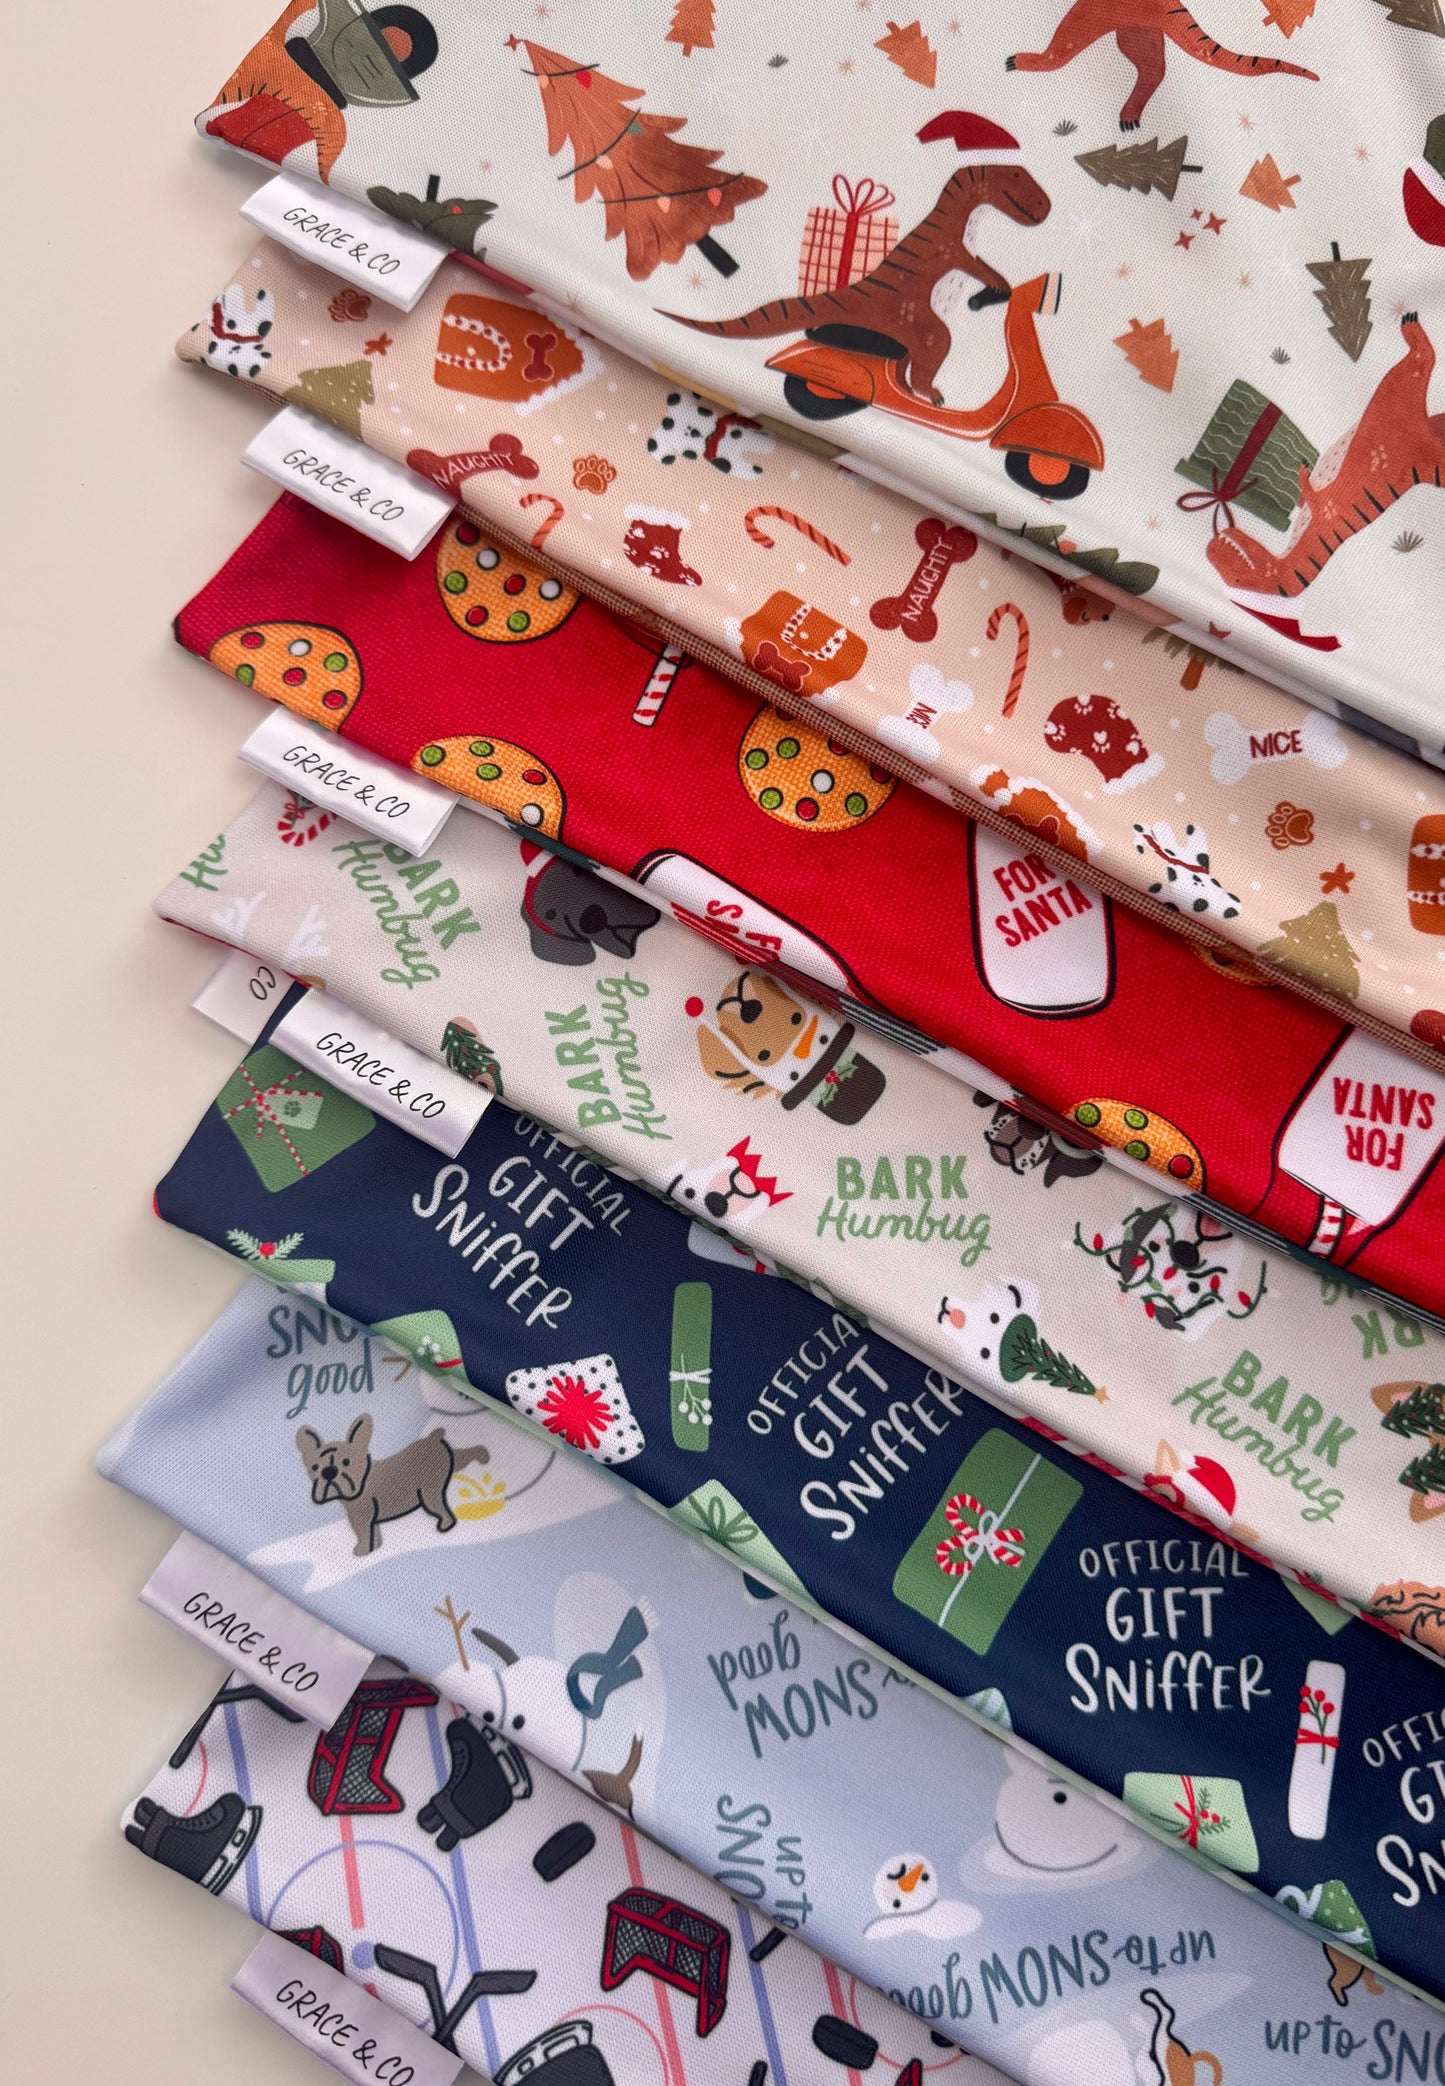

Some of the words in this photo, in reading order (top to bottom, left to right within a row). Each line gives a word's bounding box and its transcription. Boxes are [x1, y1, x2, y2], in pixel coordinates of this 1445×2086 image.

[283, 207, 354, 250] GRACE
[348, 242, 367, 260] &
[367, 251, 400, 276] CO
[283, 448, 355, 495] GRACE
[349, 487, 368, 507] &
[369, 497, 405, 522] CO
[431, 452, 515, 489] NAUGHTY
[901, 536, 954, 623] NAUGHTY
[283, 745, 359, 792] GRACE
[355, 783, 374, 801] &
[374, 796, 410, 819] CO
[1250, 729, 1303, 759] NICE
[331, 838, 442, 991] Humbug
[993, 853, 1057, 903] FOR
[995, 880, 1093, 948] SANTA
[249, 965, 277, 1001] CO
[316, 1031, 389, 1086] GRACE
[388, 1078, 410, 1100] &
[409, 1092, 447, 1119] CO
[544, 1004, 622, 1129] BARK
[594, 971, 673, 1141] Humbug
[1332, 1075, 1436, 1131] SANTA
[514, 1114, 631, 1237] OFFICIAL
[836, 1154, 970, 1201] BARK
[1345, 1126, 1406, 1172] FOR
[489, 1155, 595, 1251] GIFT
[815, 1195, 992, 1268] Humbug
[286, 1337, 374, 1420] good
[746, 1311, 862, 1435] OFFICIA
[793, 1344, 890, 1460] GIFT
[1220, 1348, 1358, 1469] BARK
[1171, 1376, 1346, 1524] Humbug
[1078, 1538, 1250, 1579] OFFICIAL
[183, 1591, 264, 1655] GRACE
[259, 1645, 284, 1675] &
[281, 1661, 320, 1693] CO
[1105, 1586, 1225, 1643] GIFT
[707, 1609, 800, 1711] good
[743, 1658, 879, 1759] SNOW
[1361, 1706, 1445, 1769] OFFI
[714, 1793, 771, 1902] SNO
[979, 1928, 1112, 2024] SNOW
[1113, 1934, 1162, 1976] to
[275, 1979, 359, 2047] GRACE
[353, 2039, 380, 2070] &
[375, 2056, 416, 2086] CO
[1314, 2014, 1368, 2059] to
